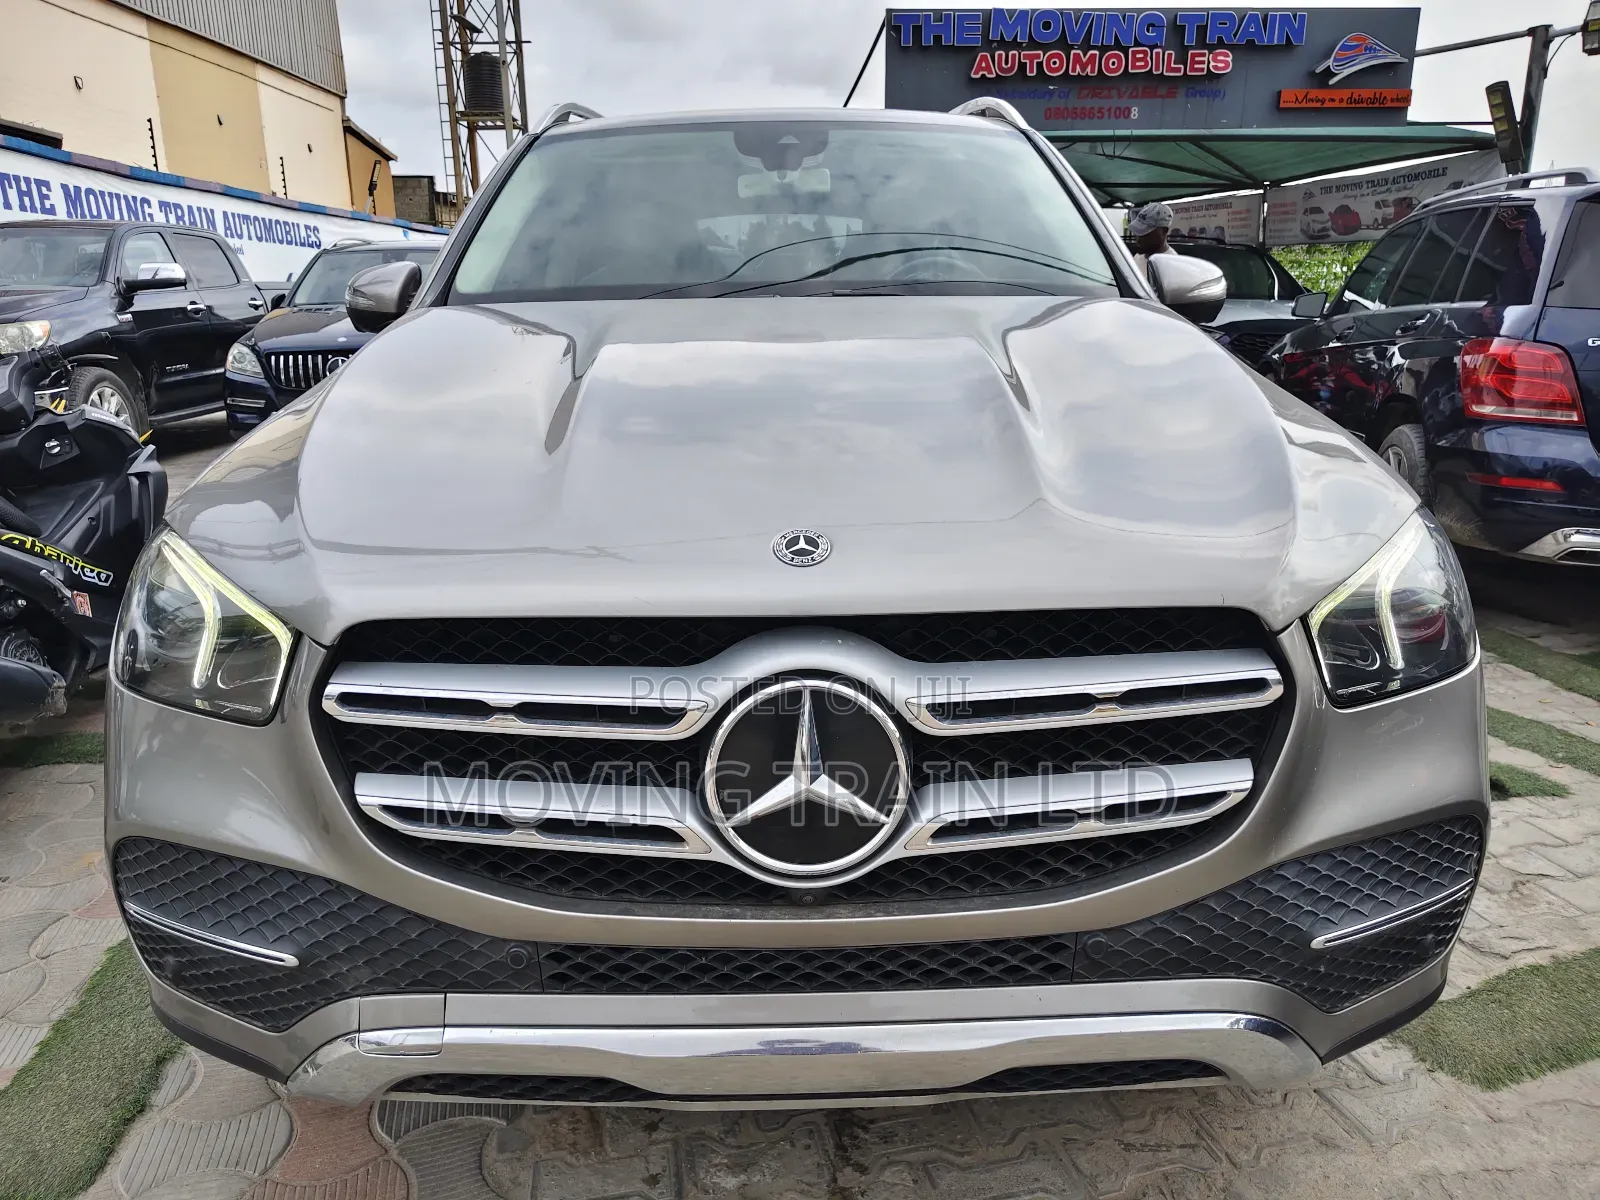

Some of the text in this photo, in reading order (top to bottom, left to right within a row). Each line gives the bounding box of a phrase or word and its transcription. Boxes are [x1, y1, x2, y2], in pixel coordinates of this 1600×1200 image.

[892, 8, 1308, 46] THE MOVING TRAIN
[971, 47, 1233, 78] AUTOMOBILES
[1076, 85, 1180, 100] DRIVABLE
[1346, 91, 1389, 106] drivable
[1320, 185, 1333, 195] THE
[1334, 181, 1363, 193] MOVING
[1365, 178, 1389, 190] TRAIN
[1391, 166, 1448, 185] AUTOMOBILE
[0, 172, 322, 250] THE MOVING TRAIN AUTOMOBILES
